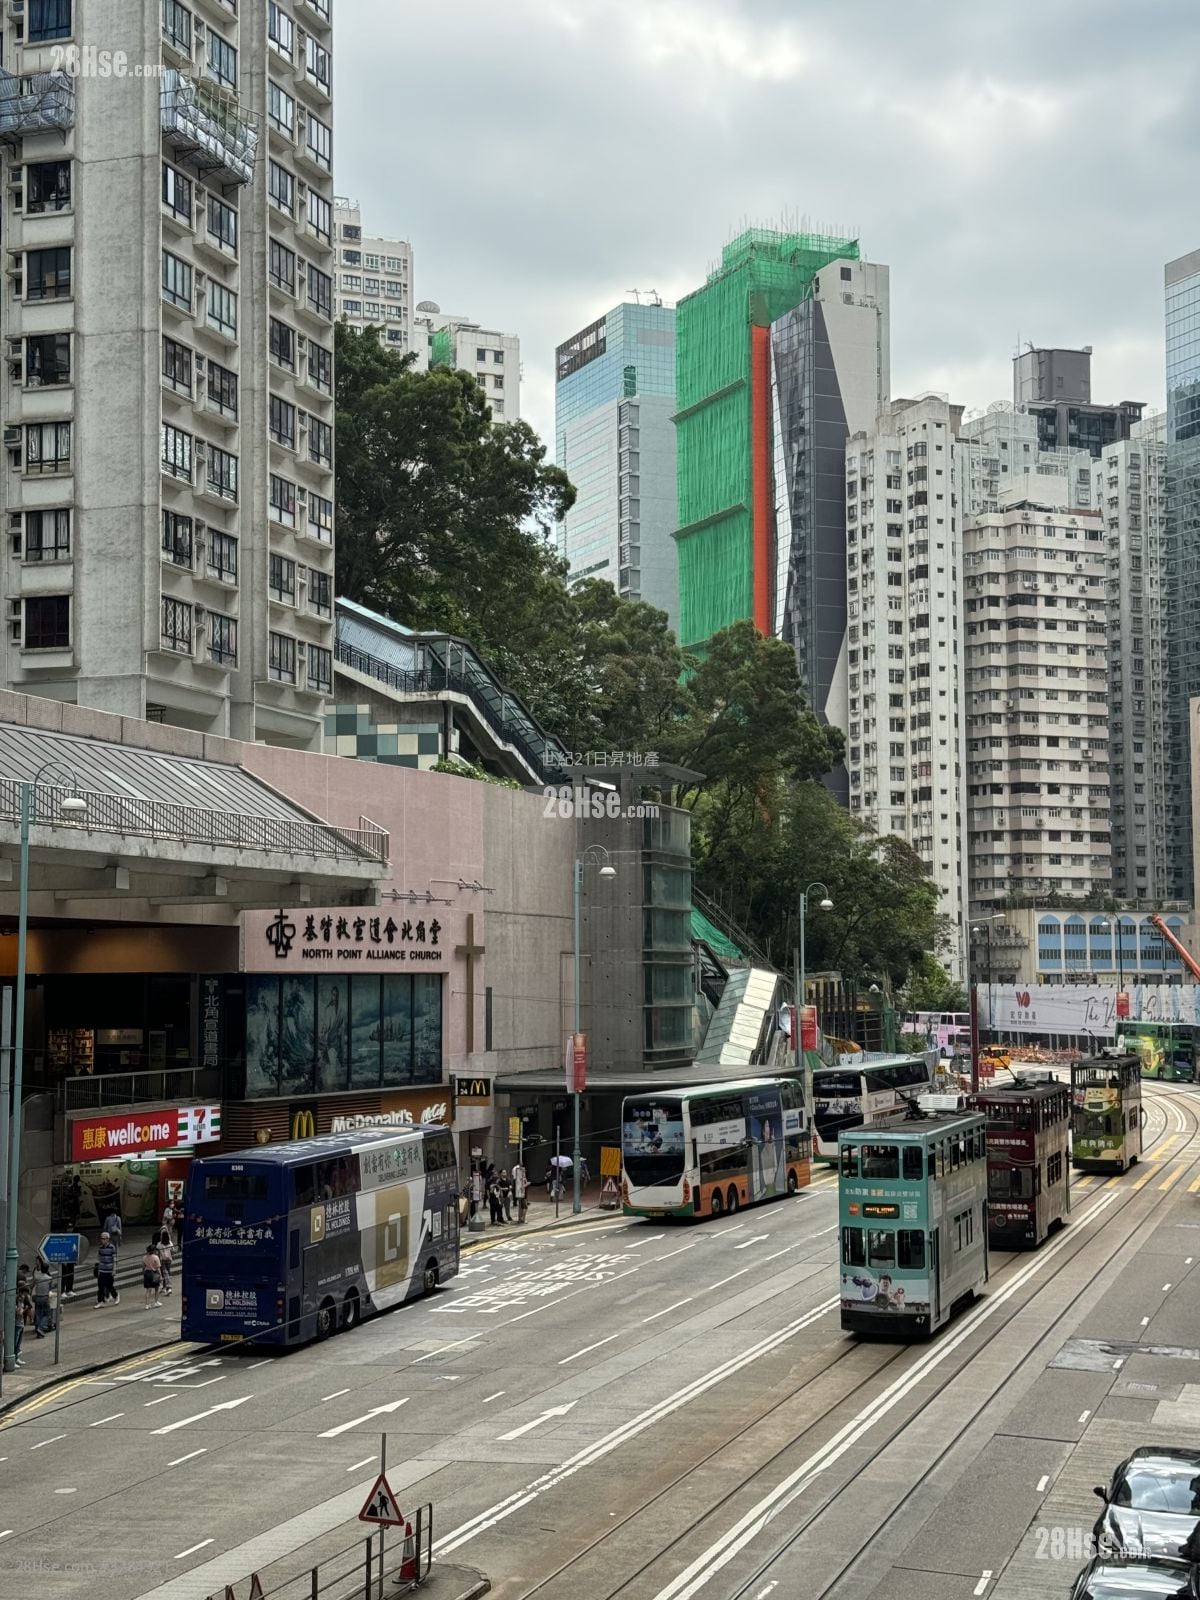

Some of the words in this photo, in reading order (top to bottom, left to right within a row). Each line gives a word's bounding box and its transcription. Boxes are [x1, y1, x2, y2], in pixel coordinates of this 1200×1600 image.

[302, 914, 442, 945] 基督教宣道會北角堂
[302, 948, 333, 959] NORTH
[337, 949, 362, 959] POINT
[366, 950, 406, 960] ALLIANCE
[409, 951, 442, 960] CHURCH
[203, 994, 219, 1066] 北角宣道書局
[332, 1109, 413, 1132] McDonald's
[82, 1127, 107, 1149] 惠康
[107, 1122, 170, 1147] wellcome
[565, 1254, 641, 1262] GIVE
[503, 1271, 547, 1280] TO
[543, 1271, 615, 1280] BUS
[544, 1263, 618, 1271] WAY
[430, 1296, 528, 1313] 巴士
[915, 1316, 926, 1324] 47
